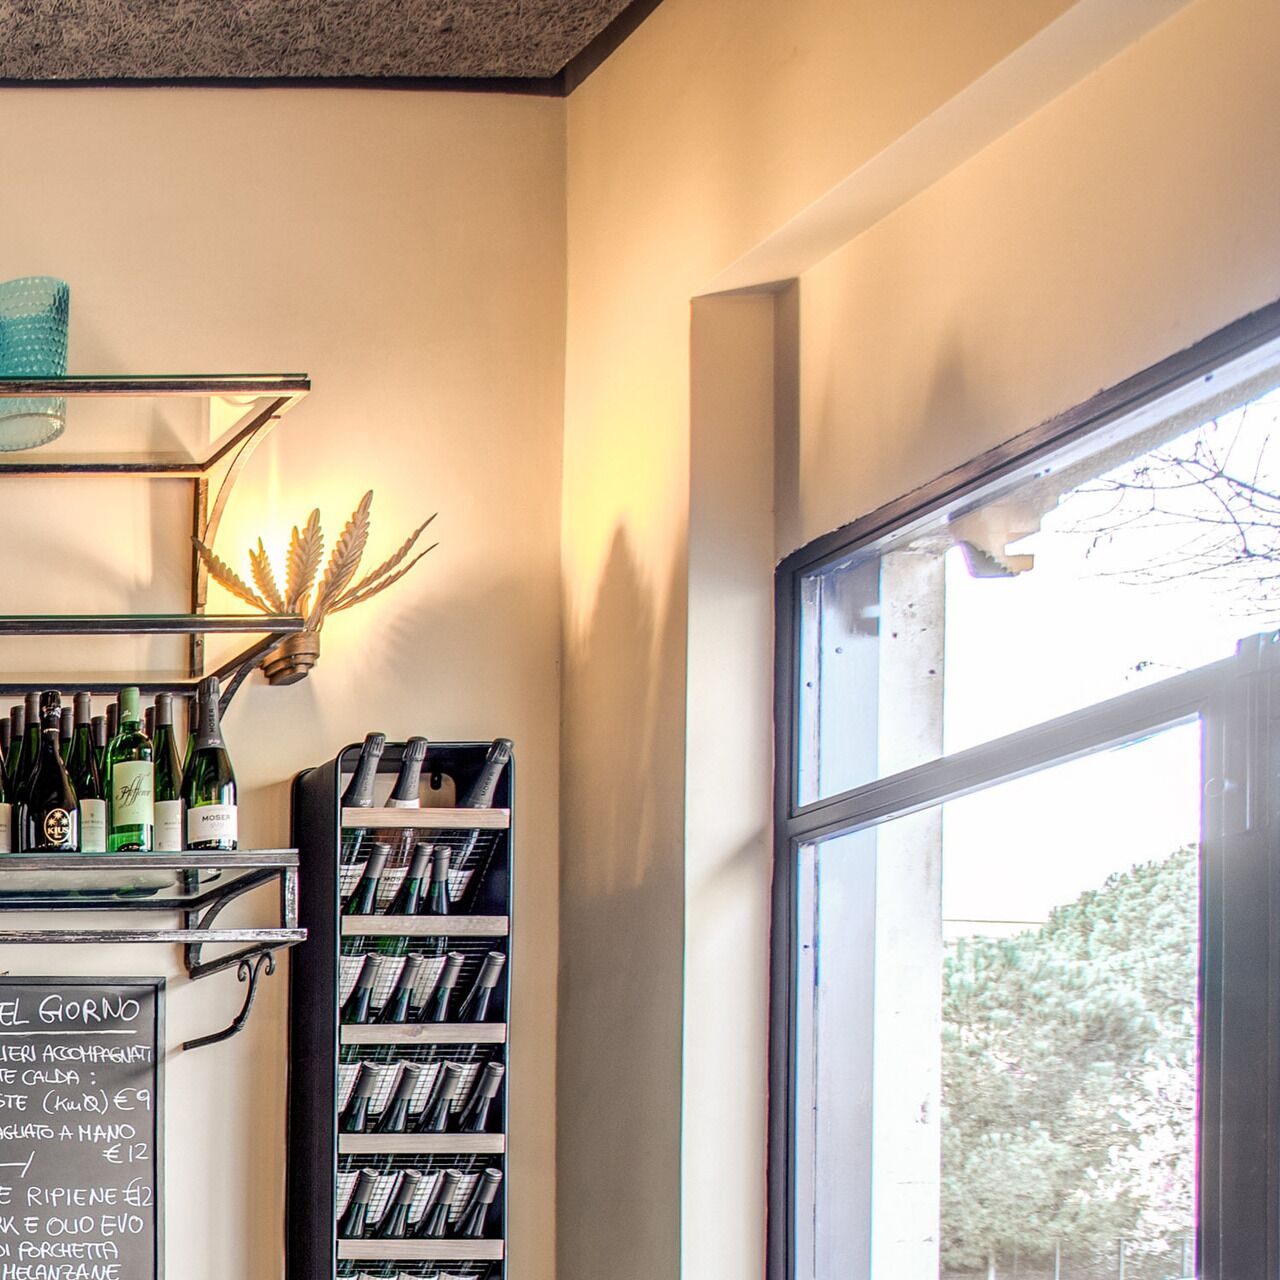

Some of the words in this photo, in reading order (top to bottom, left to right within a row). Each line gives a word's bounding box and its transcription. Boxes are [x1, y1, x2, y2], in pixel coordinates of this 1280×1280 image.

[38, 994, 140, 1024] GIORNO
[42, 1044, 151, 1064] ACCOMPAGNATI
[58, 1124, 74, 1141] A
[78, 1123, 136, 1143] MANO
[27, 1186, 118, 1207] RIPIENE
[23, 1216, 40, 1234] E
[46, 1215, 94, 1237] OLIO
[100, 1212, 144, 1237] EVO
[18, 1240, 119, 1262] PORCHETTA
